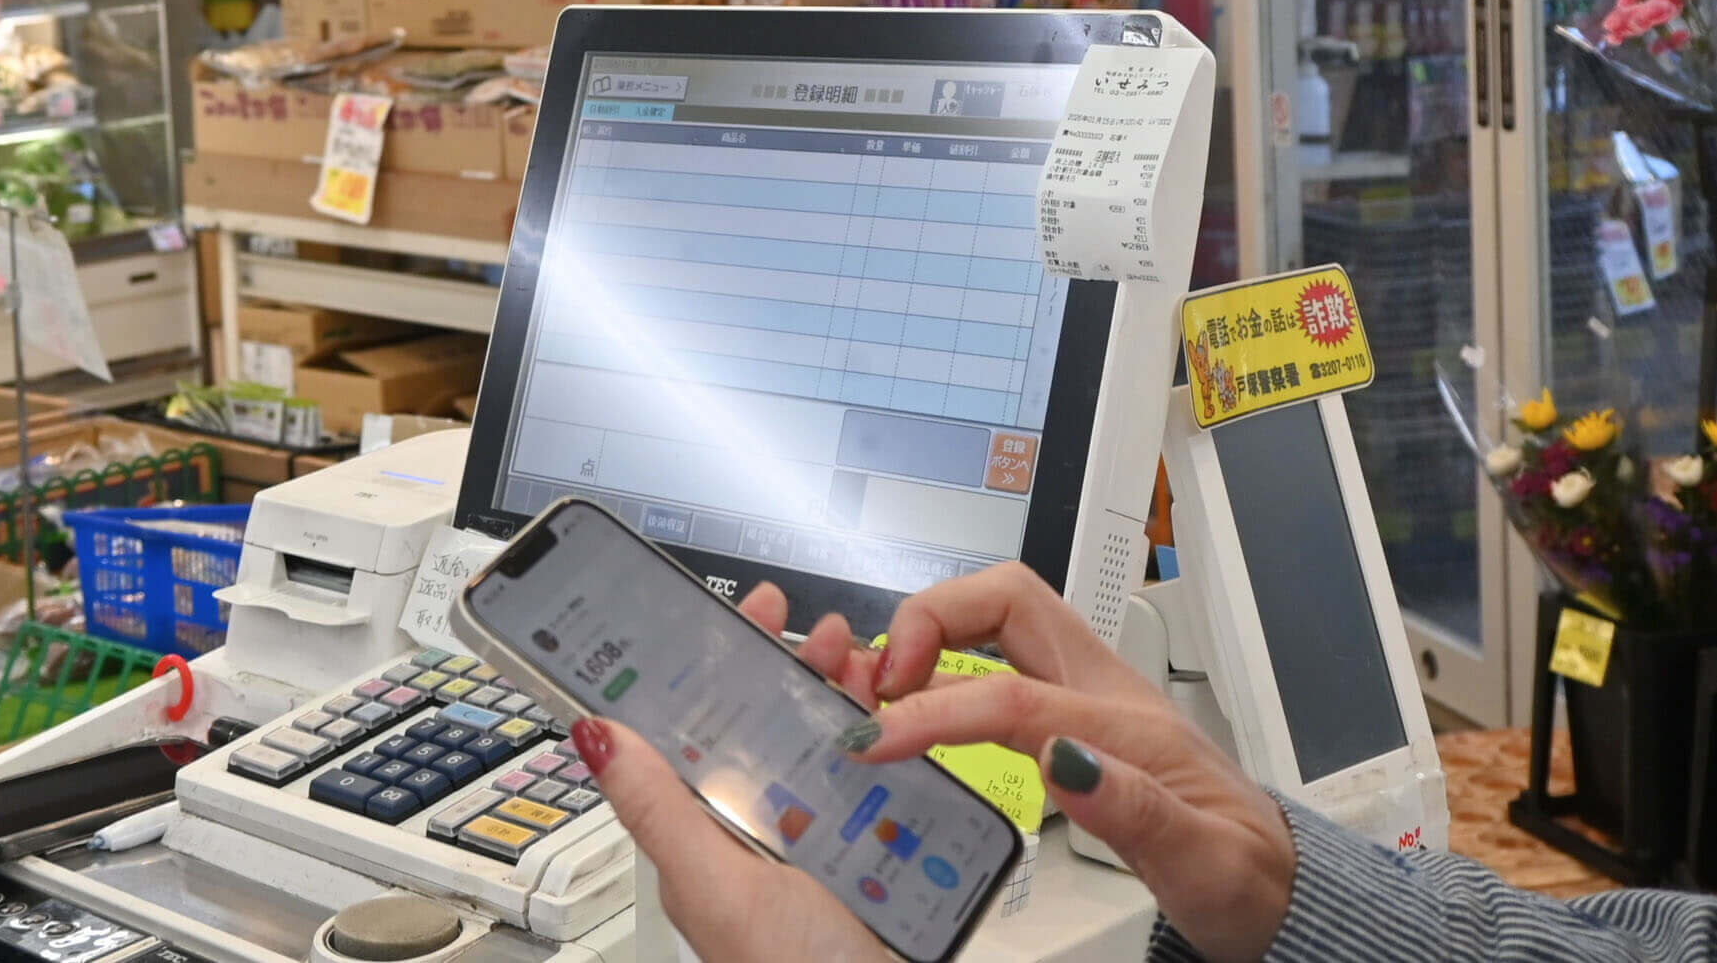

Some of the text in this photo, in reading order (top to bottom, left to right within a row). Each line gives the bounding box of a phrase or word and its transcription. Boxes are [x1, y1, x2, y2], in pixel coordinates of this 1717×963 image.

[1095, 78, 1169, 90] いせみつ
[793, 83, 859, 104] 登録明細
[721, 132, 747, 143] 商品名
[866, 139, 885, 151] 数量
[902, 141, 922, 153] 単価
[1206, 293, 1350, 349] 電話でお金の話は 詐欺
[1235, 362, 1301, 402] 戸塚警察署
[1003, 439, 1026, 454] 登録
[581, 459, 595, 477] 点
[992, 455, 1030, 471] ボタンへ
[706, 576, 737, 596] TEC
[463, 710, 479, 719] C
[420, 720, 437, 730] 7
[447, 729, 463, 739] 8
[388, 738, 403, 747] 4
[477, 737, 493, 748] 9
[416, 747, 430, 756] 5
[358, 756, 374, 765] 1
[446, 755, 463, 765] 6
[384, 764, 401, 773] 2
[339, 776, 355, 786] 0
[415, 773, 432, 782] 3
[380, 789, 403, 801] 00
